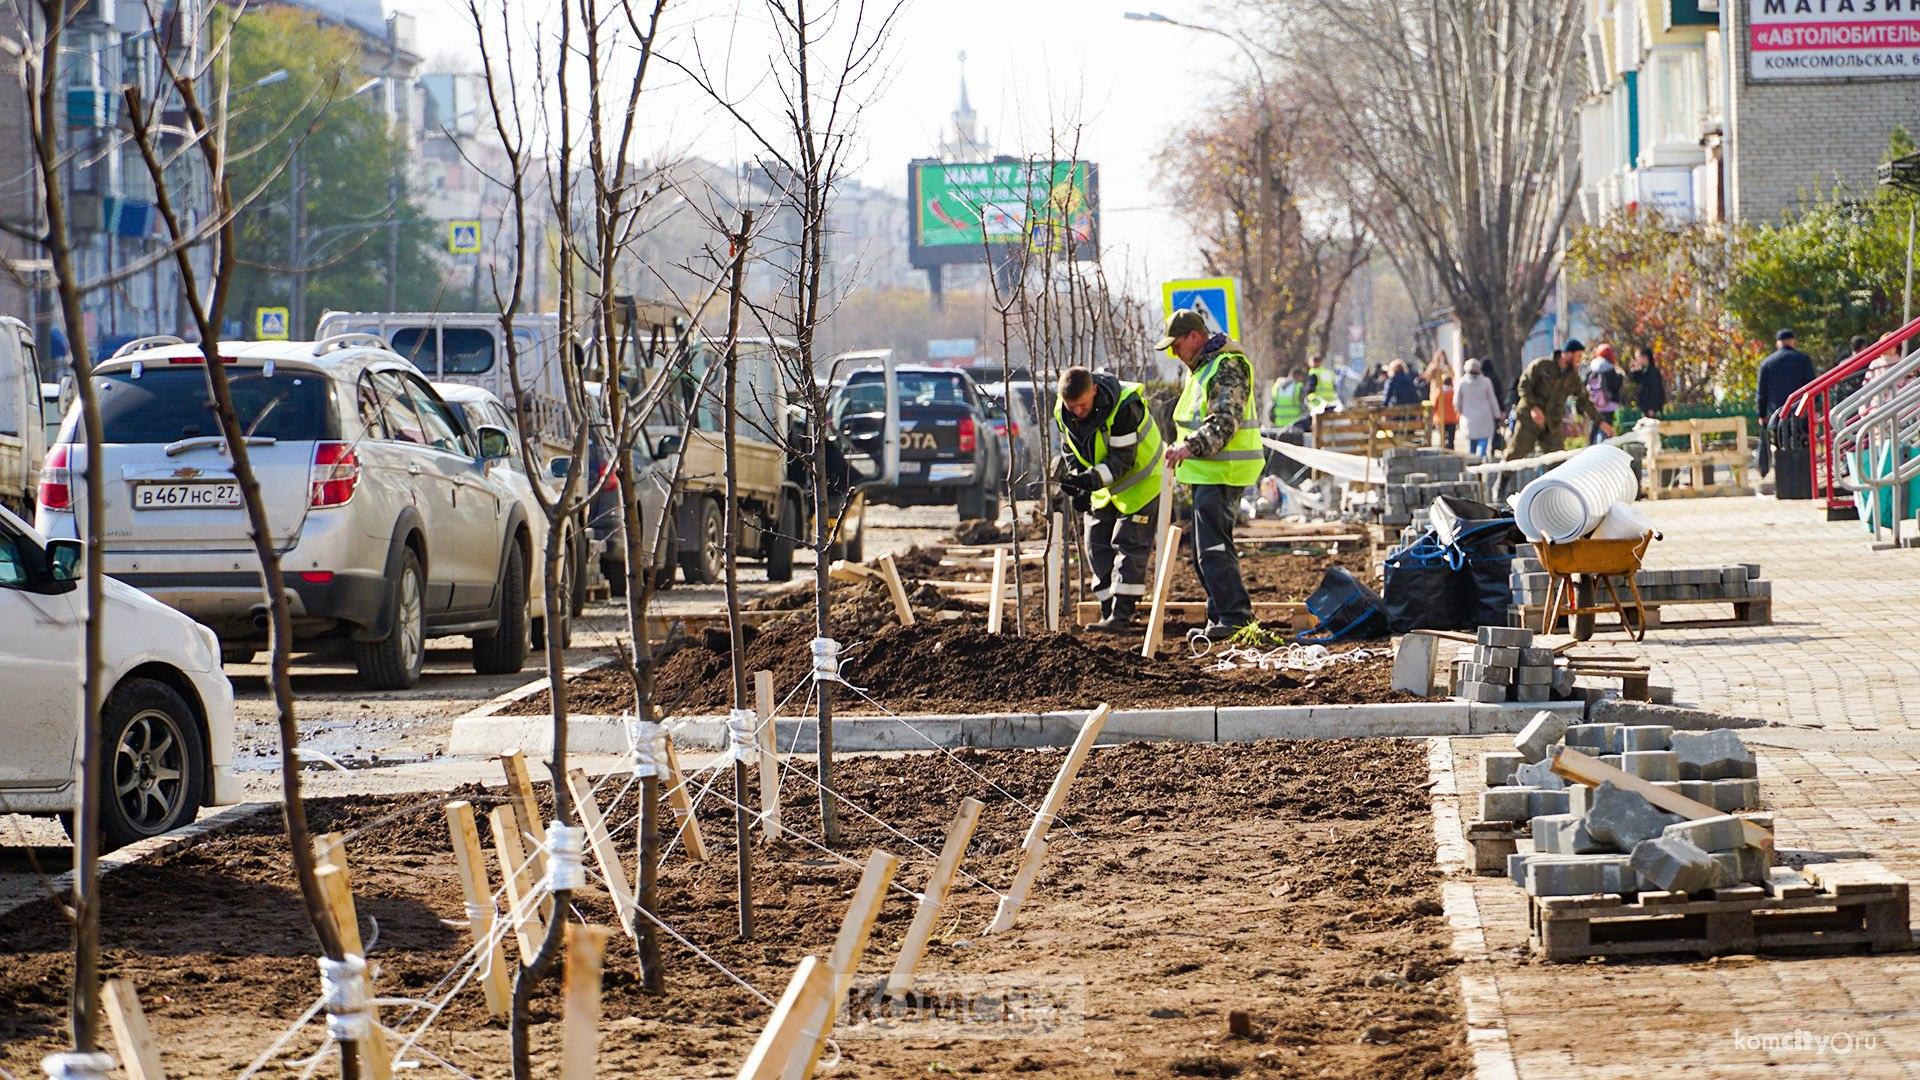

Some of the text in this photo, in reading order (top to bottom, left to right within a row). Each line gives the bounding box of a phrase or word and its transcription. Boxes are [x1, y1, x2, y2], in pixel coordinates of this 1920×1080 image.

[1764, 53, 1909, 69] КОМСОМОЛЬСКАЯ,
[899, 432, 938, 450] OTA
[217, 486, 235, 499] 27
